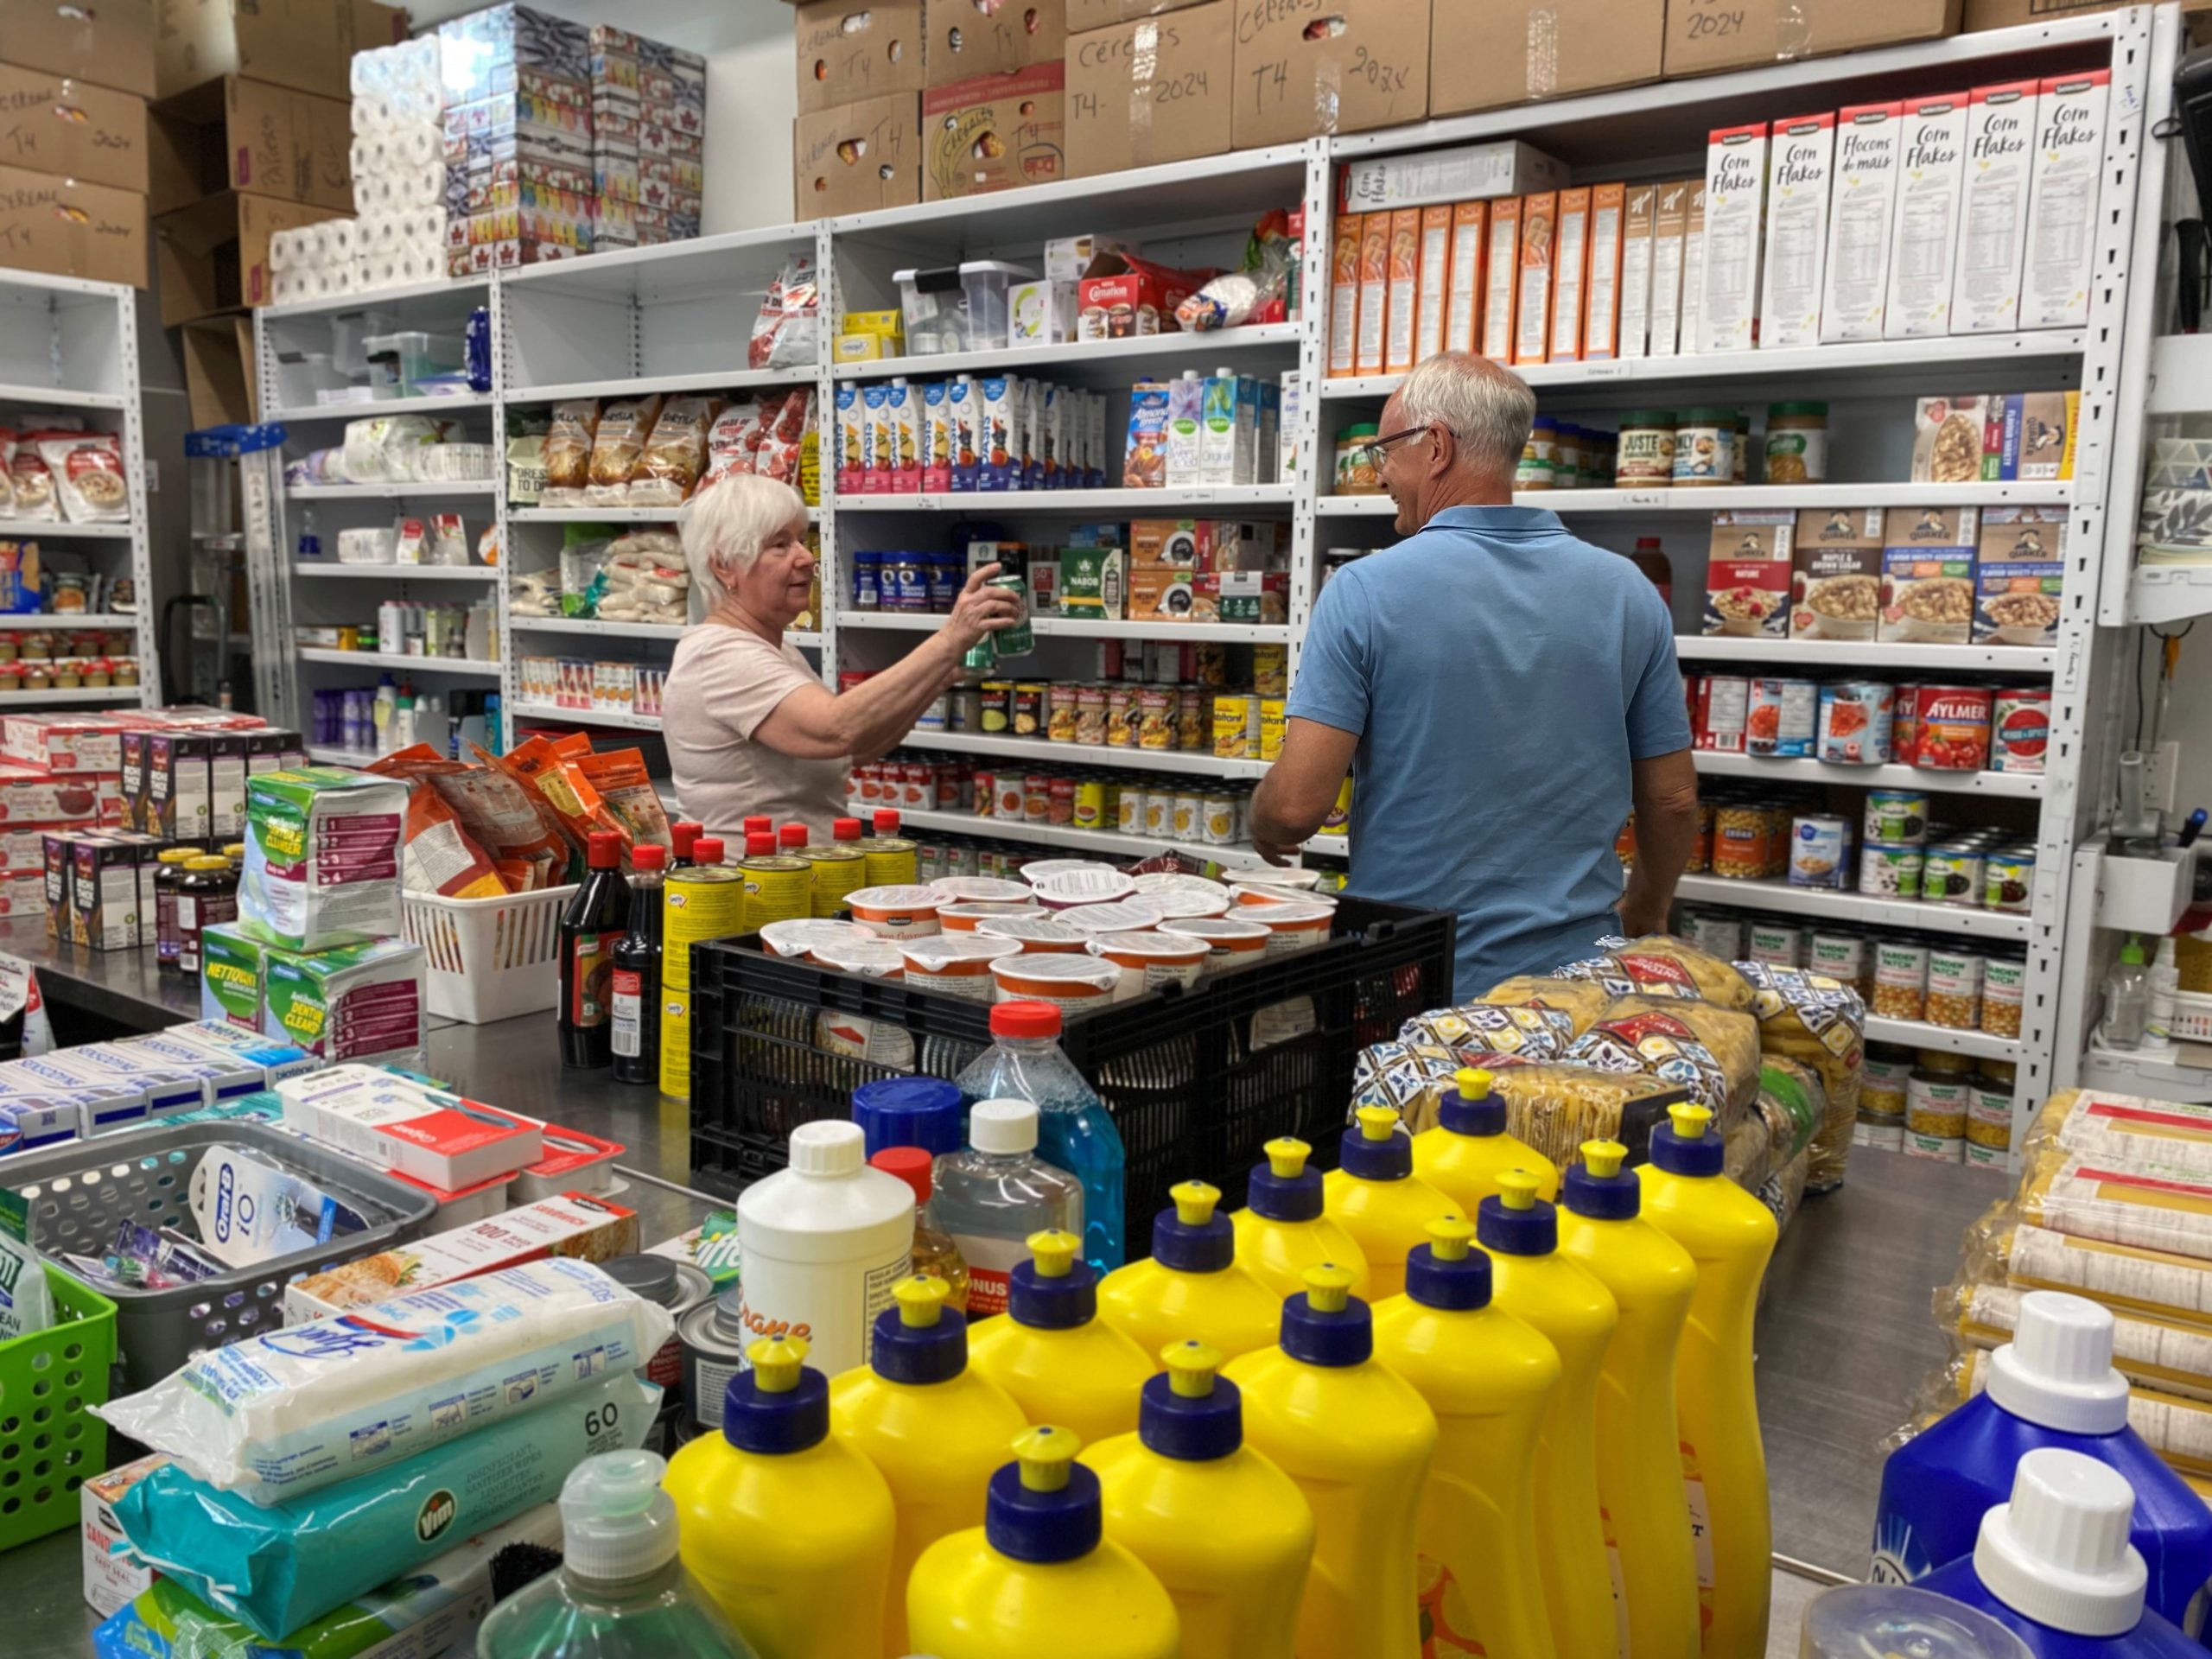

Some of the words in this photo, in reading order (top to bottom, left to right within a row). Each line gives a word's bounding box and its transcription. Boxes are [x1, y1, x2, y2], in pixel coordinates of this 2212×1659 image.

[1688, 11, 1745, 38] 2024
[1079, 27, 1180, 68] Cérées
[842, 50, 871, 83] T4
[1156, 72, 1209, 103] 2024
[1252, 60, 1288, 114] T4
[1984, 114, 2018, 134] Corn
[2053, 104, 2088, 124] Corn
[7, 124, 36, 155] T4
[870, 117, 904, 162] T4
[1916, 124, 1950, 145] Corn
[2042, 128, 2097, 149] Flakes
[1786, 143, 1817, 164] Corn
[1843, 135, 1891, 157] Flocons
[1974, 137, 2026, 158] Flakes
[1720, 153, 1750, 172] Corn
[1842, 158, 1856, 172] de
[1906, 146, 1958, 168] Flakes
[1357, 172, 1371, 198] Corn
[1371, 164, 1387, 203] Flakes
[1713, 175, 1757, 194] Flakes
[1777, 166, 1824, 186] Flakes
[1089, 284, 1128, 302] Carnation
[982, 416, 990, 465] OASIS
[1625, 434, 1659, 449] JUSTE
[1676, 434, 1696, 448] NLY
[518, 479, 531, 491] TO
[1909, 531, 1950, 541] QUAKER
[2009, 550, 2048, 559] QUAKER
[1071, 577, 1099, 587] NABOB
[1735, 569, 1760, 579] NATURE
[1255, 648, 1280, 658] bitant
[1926, 702, 1986, 720] AYLMER
[331, 837, 338, 847] 2
[1726, 829, 1754, 839] CEDAR
[331, 854, 339, 864] 3
[332, 872, 341, 882] 4
[1881, 950, 1916, 963] GARDEN
[1883, 958, 1912, 969] PATCH
[1930, 957, 1965, 969] GARDEN
[1931, 966, 1960, 977] PATCH
[291, 1001, 324, 1024] DENTUR
[75, 1046, 141, 1071] SENSODYNE
[141, 1039, 204, 1062] SENSODYNE
[18, 1058, 86, 1087] SENSODYNE
[275, 1064, 315, 1082] biotène
[217, 1164, 233, 1243] Oral-B
[238, 1194, 256, 1236] iO
[472, 1223, 510, 1239] 100
[0, 1311, 21, 1332] EAN
[584, 1402, 619, 1437] 60
[420, 1499, 453, 1539] Vim
[94, 1554, 111, 1571] EASY
[113, 1567, 130, 1583] SEAL
